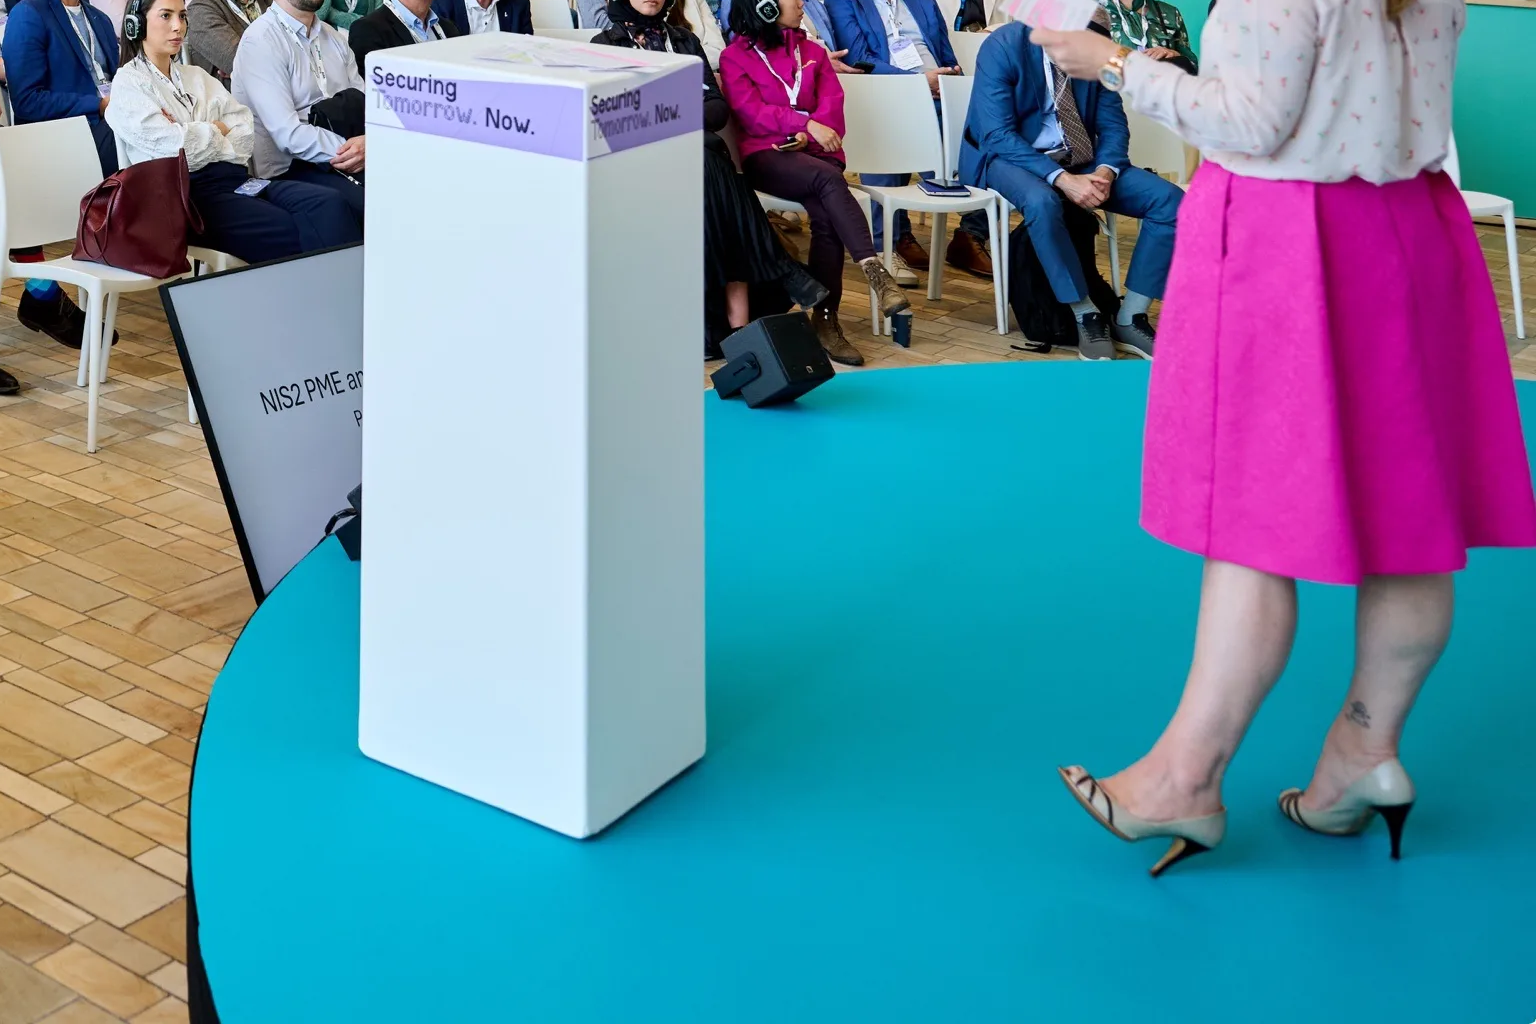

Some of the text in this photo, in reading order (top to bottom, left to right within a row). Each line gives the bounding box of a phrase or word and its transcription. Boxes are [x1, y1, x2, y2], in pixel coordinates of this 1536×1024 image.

[373, 66, 458, 102] Securing
[591, 88, 641, 116] Securing
[372, 88, 536, 135] Tomorrow. Now.
[590, 103, 681, 140] Tomorrow. Now.
[260, 383, 305, 415] NIS2
[304, 370, 345, 402] PME
